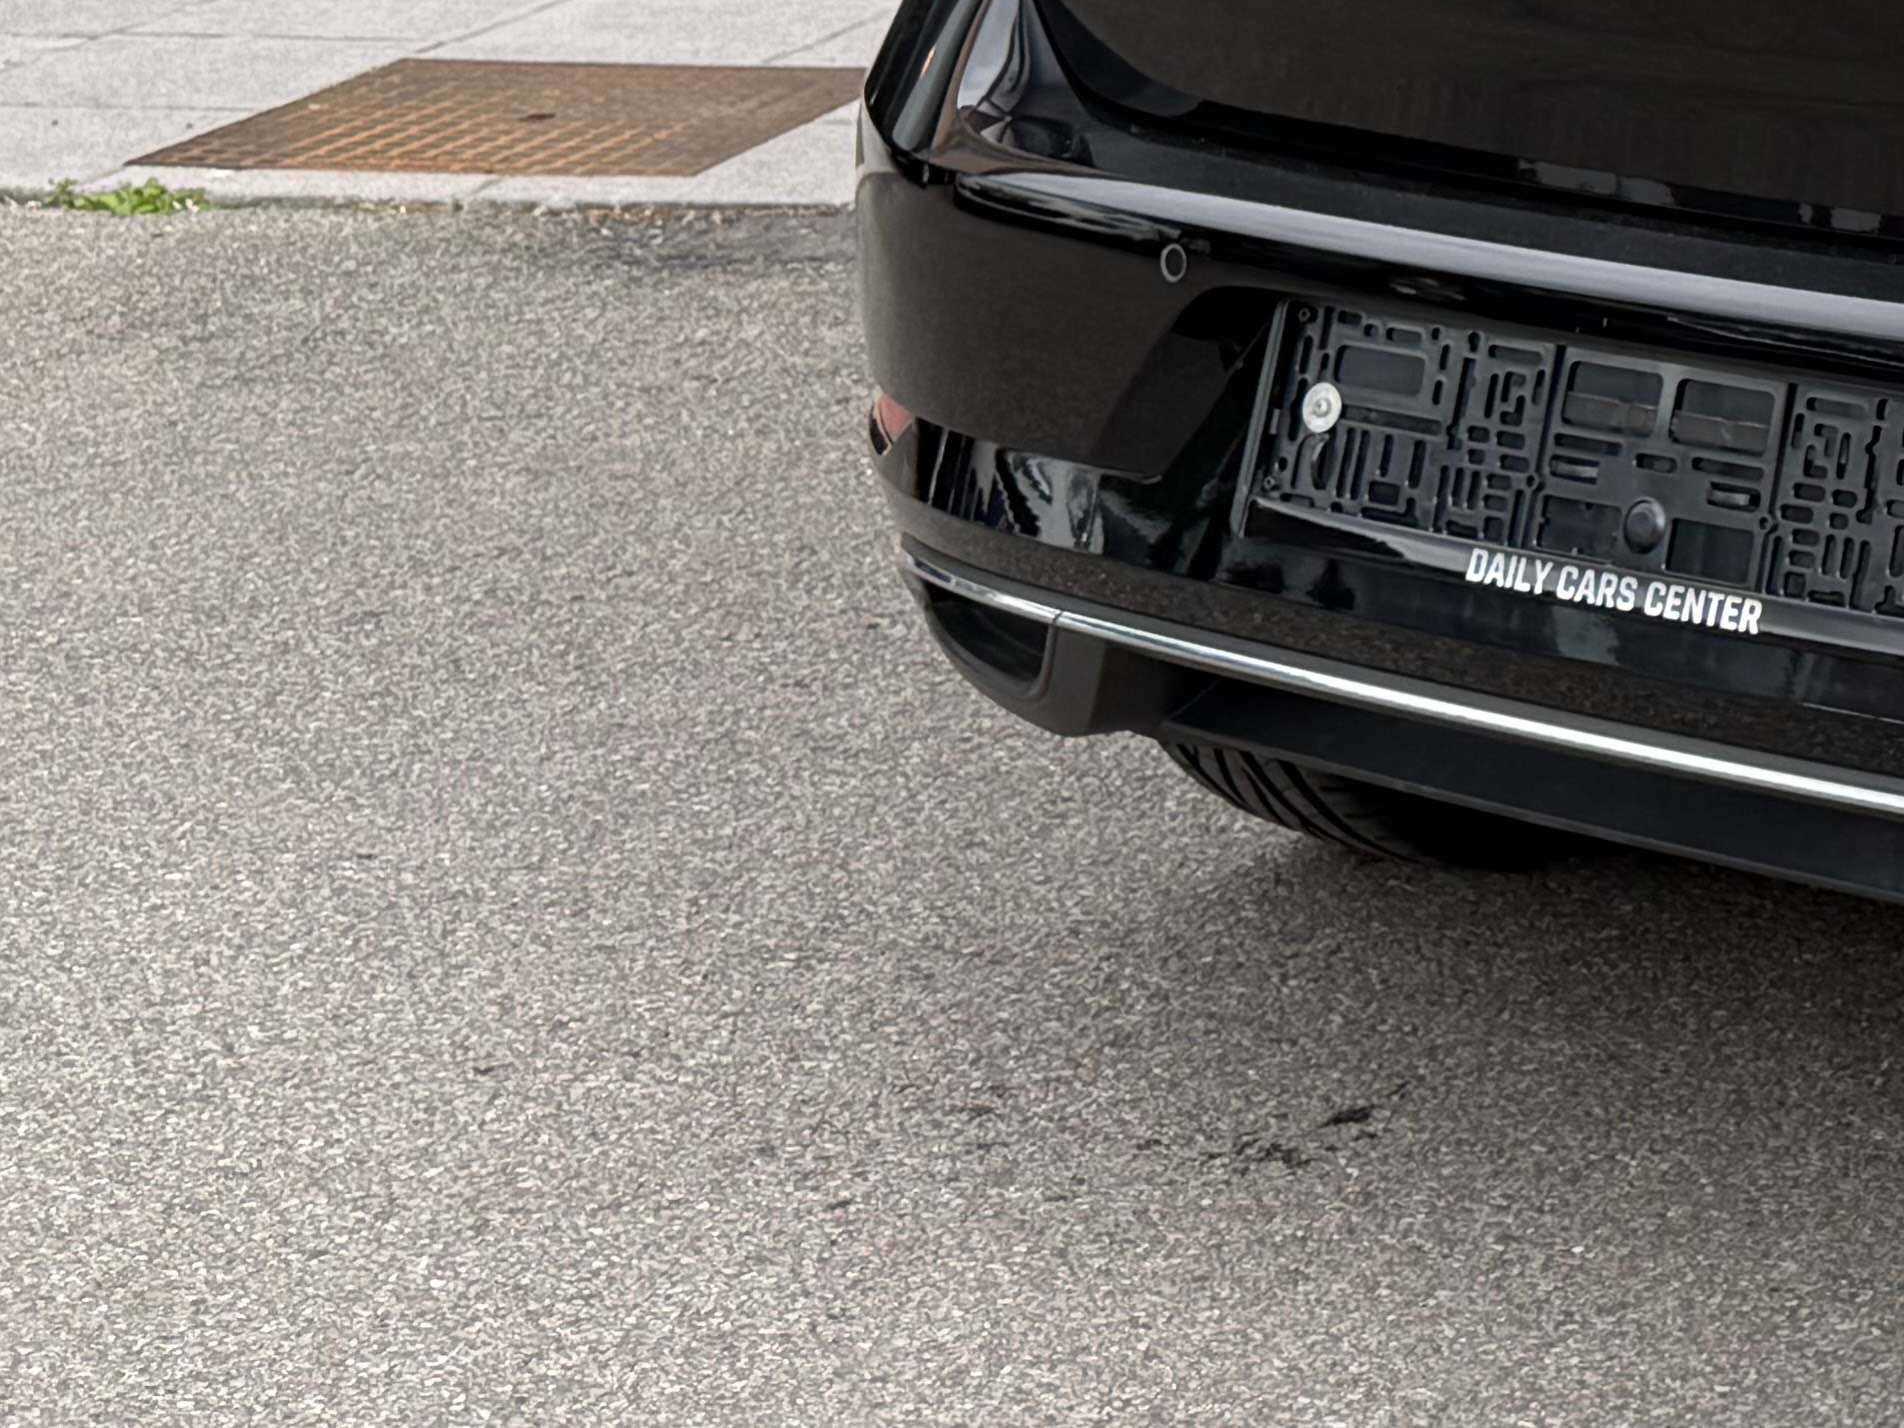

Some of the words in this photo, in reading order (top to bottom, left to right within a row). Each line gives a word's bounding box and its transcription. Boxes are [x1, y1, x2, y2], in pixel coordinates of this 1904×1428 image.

[1464, 546, 1555, 596] DAILY
[1555, 564, 1639, 613] CARS
[1642, 580, 1764, 636] CENTER
